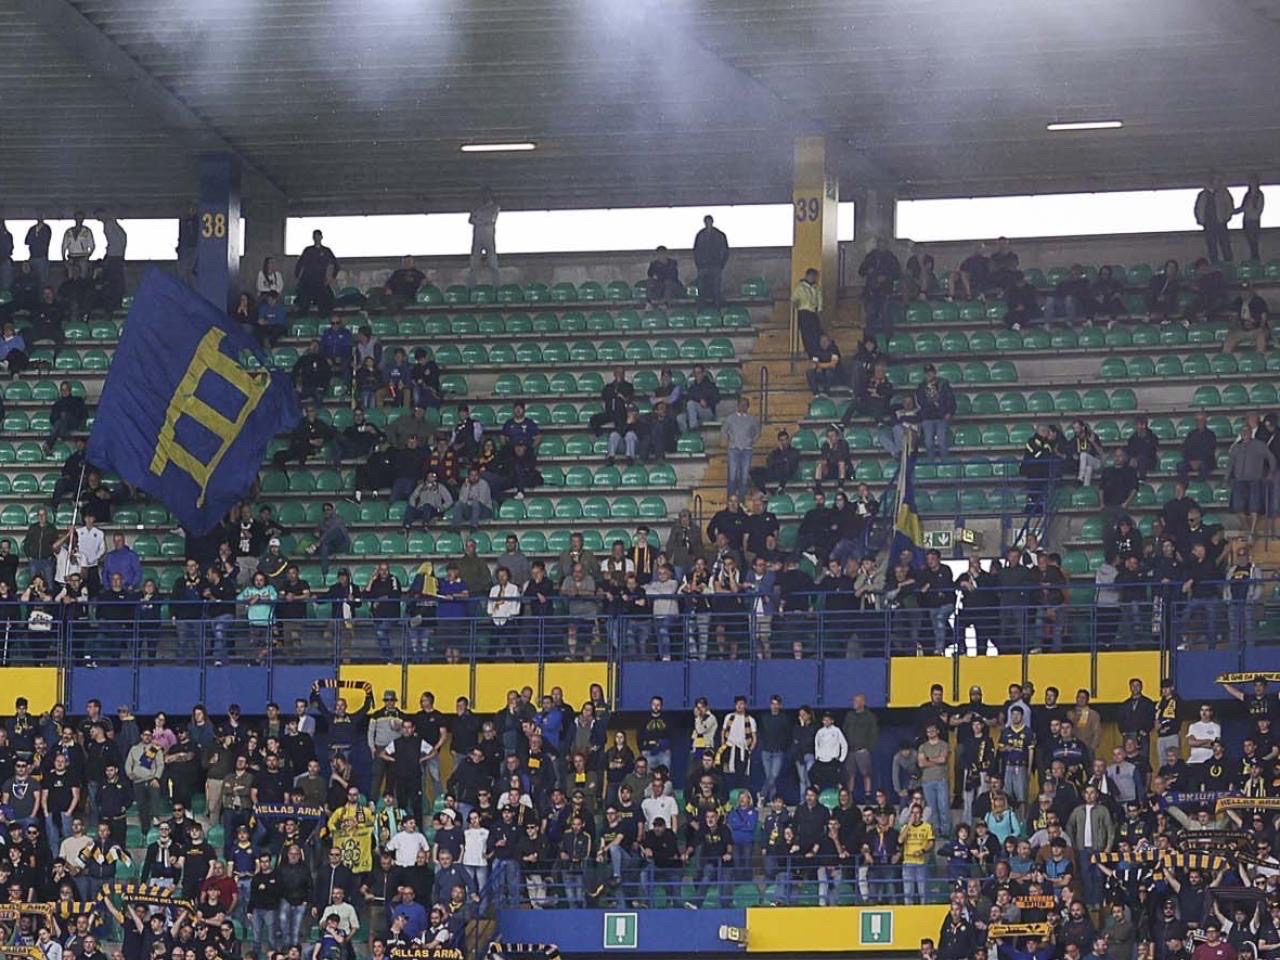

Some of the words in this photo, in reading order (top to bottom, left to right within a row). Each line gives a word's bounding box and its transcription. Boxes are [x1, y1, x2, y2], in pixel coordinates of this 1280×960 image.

[795, 196, 821, 223] 39
[201, 212, 226, 238] 38
[255, 805, 294, 814] HELLAS
